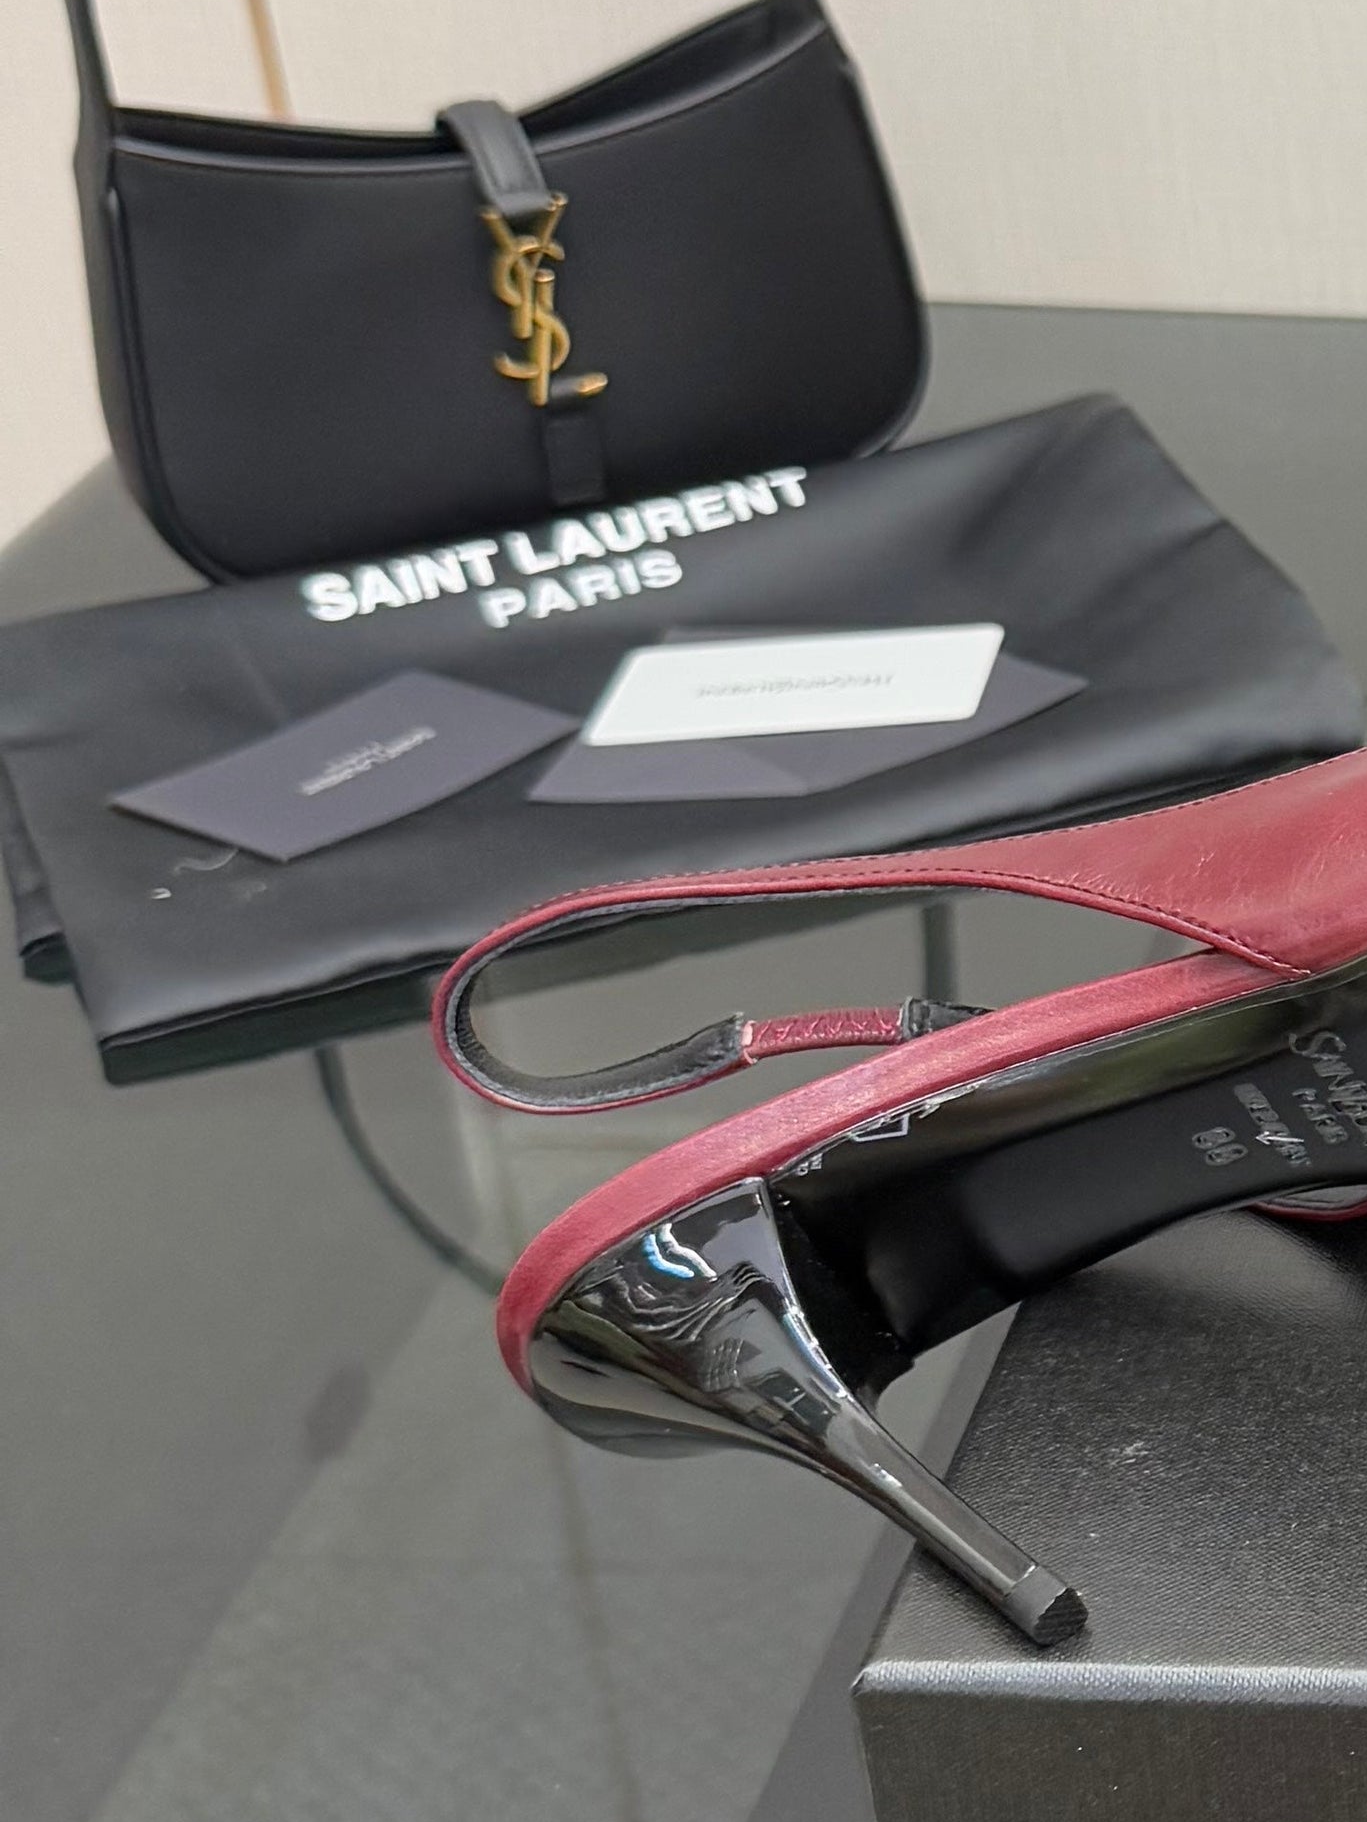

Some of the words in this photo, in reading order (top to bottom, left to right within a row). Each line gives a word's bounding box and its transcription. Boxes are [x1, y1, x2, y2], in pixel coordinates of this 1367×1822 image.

[301, 539, 499, 621] SAINT
[502, 465, 808, 576] LAURENT
[477, 548, 683, 628] PARIS
